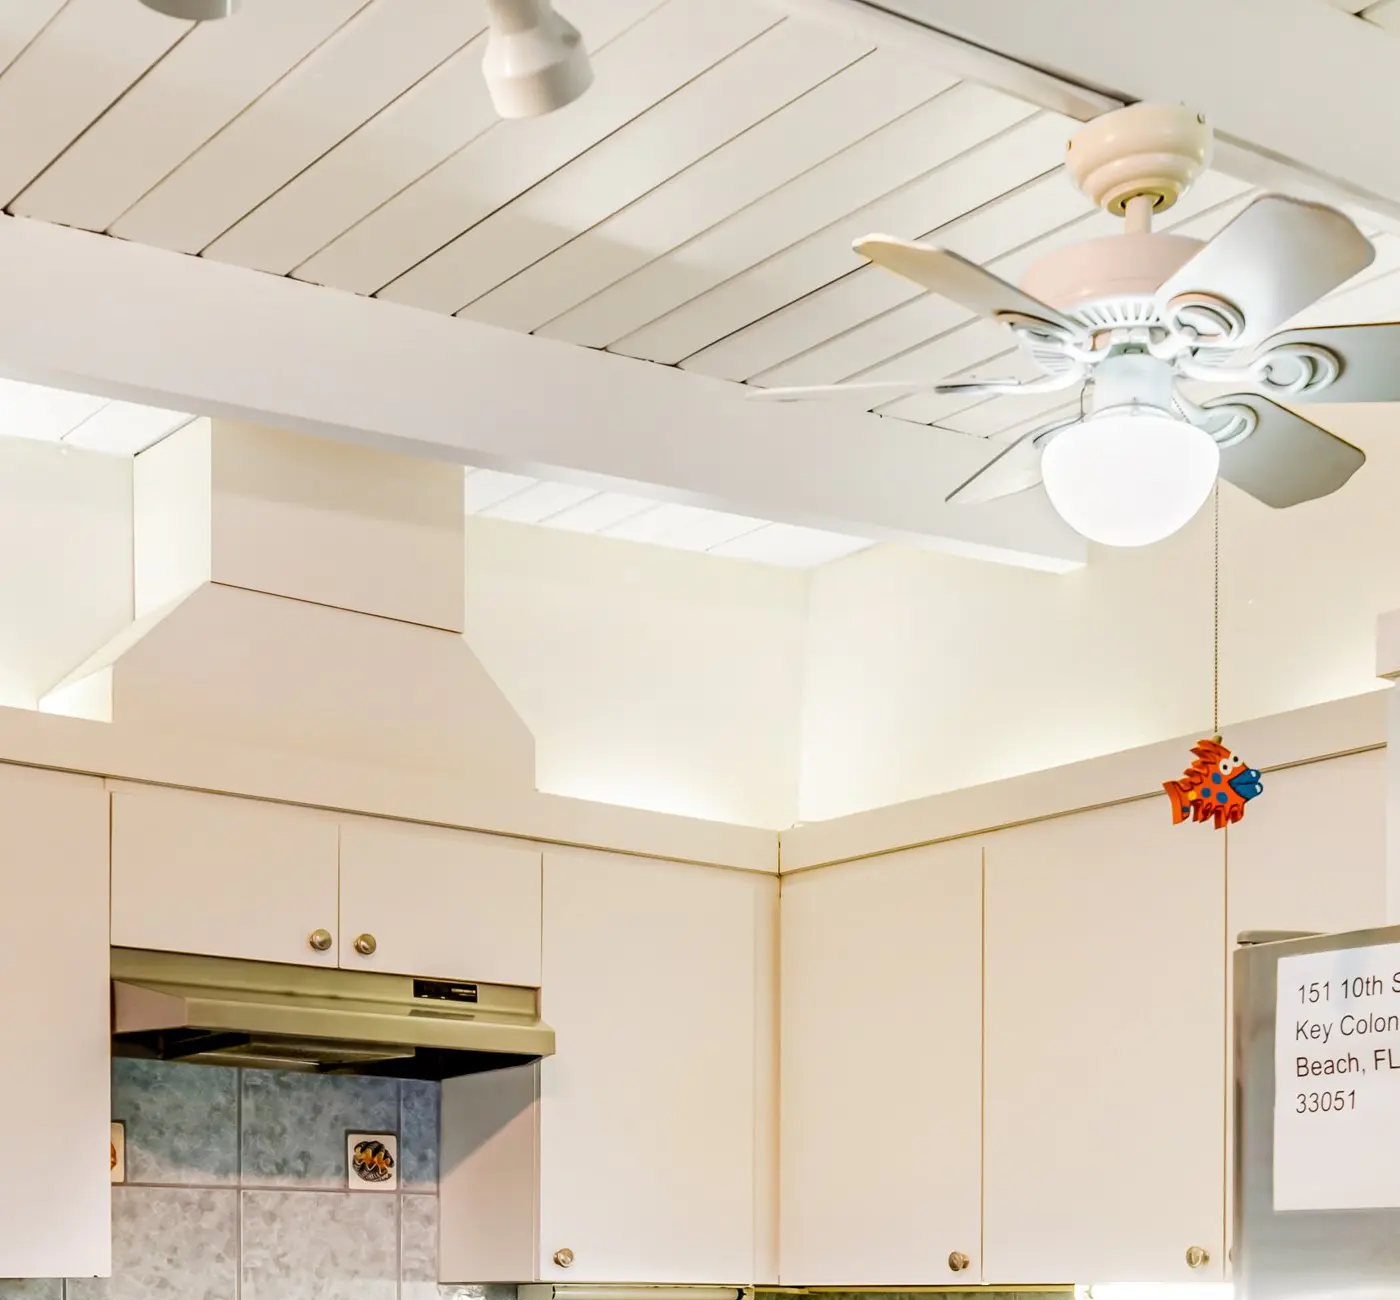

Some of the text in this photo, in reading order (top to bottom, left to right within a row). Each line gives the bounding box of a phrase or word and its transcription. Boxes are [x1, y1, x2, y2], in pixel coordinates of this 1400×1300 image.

[1298, 981, 1330, 1004] 151
[1341, 975, 1383, 999] 10th
[1296, 1019, 1333, 1044] Key
[1296, 1048, 1400, 1077] Beach, FL
[1296, 1089, 1356, 1114] 33051
